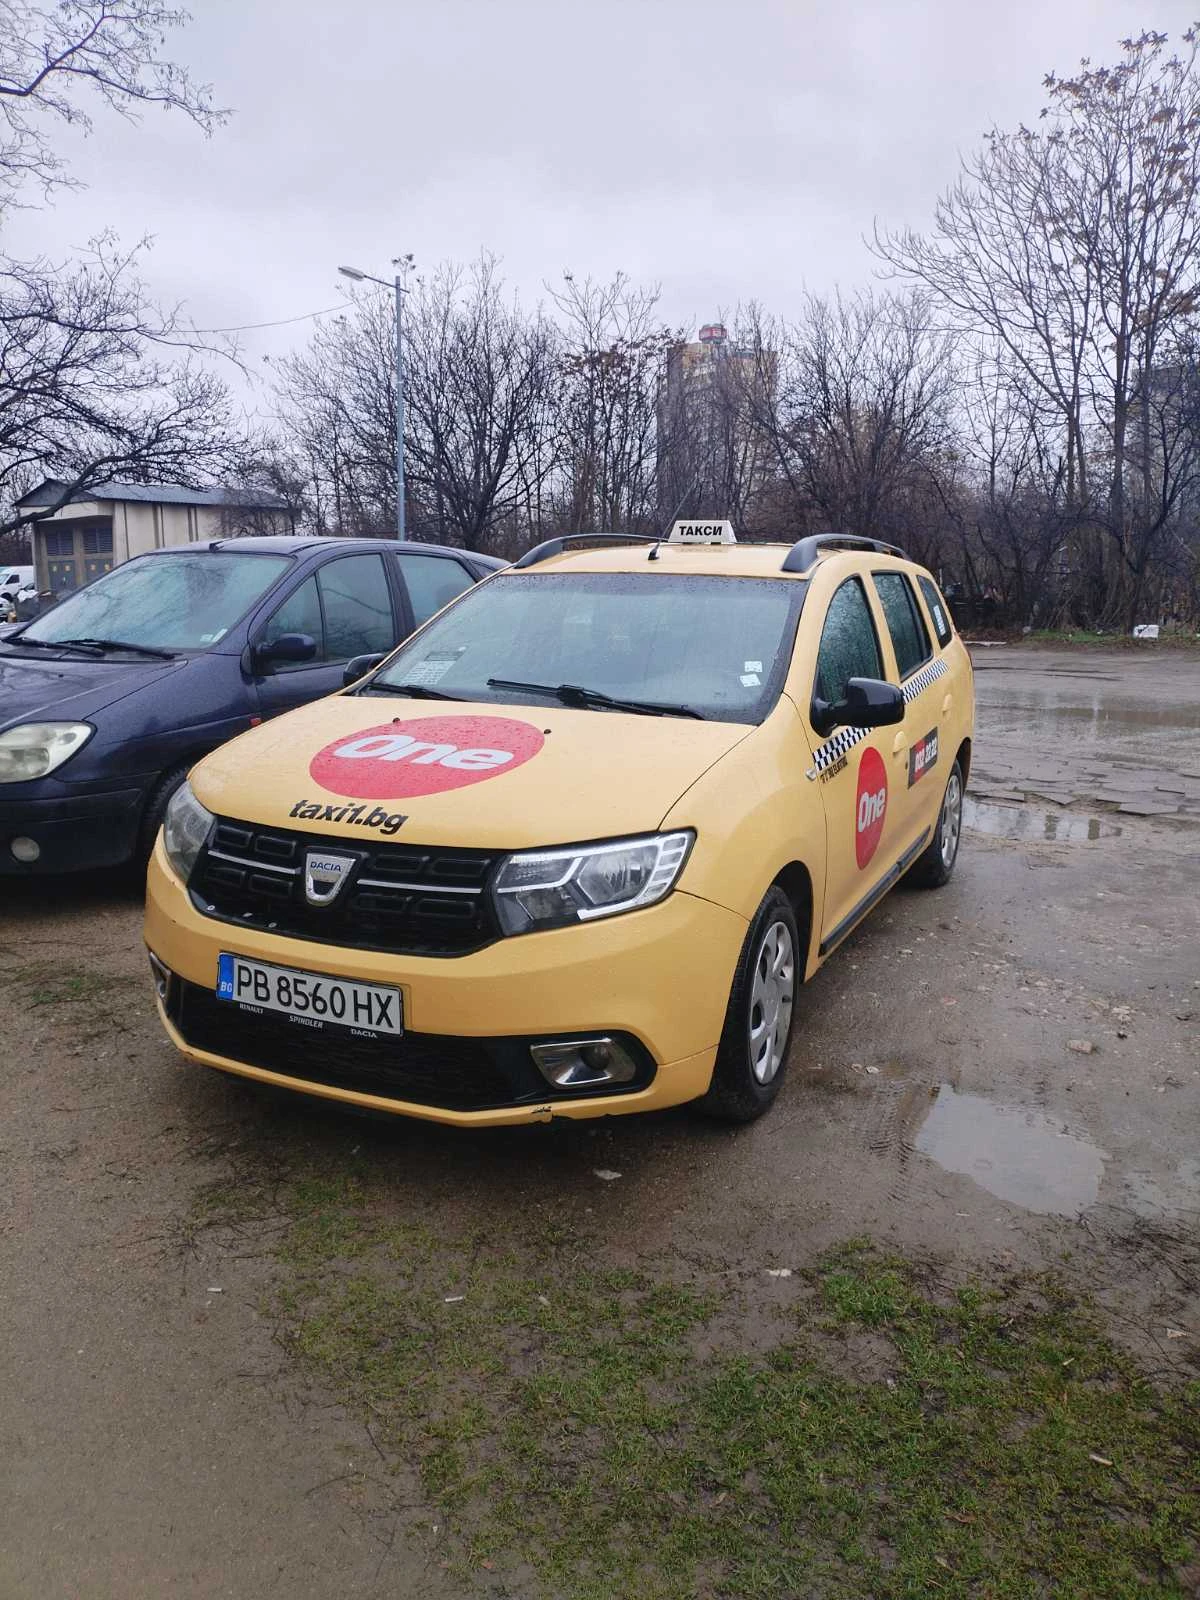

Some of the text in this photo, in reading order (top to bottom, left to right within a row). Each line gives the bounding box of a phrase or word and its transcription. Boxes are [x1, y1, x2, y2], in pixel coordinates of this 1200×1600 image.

[679, 526, 722, 536] ТАКСИ
[289, 799, 408, 835] taxi1.bg
[857, 788, 886, 833] One
[310, 861, 341, 873] DACIA
[220, 981, 233, 993] BG
[237, 964, 394, 1028] PB 8560 HX
[289, 1015, 324, 1029] SPINDLER
[351, 1028, 378, 1038] DACIA
